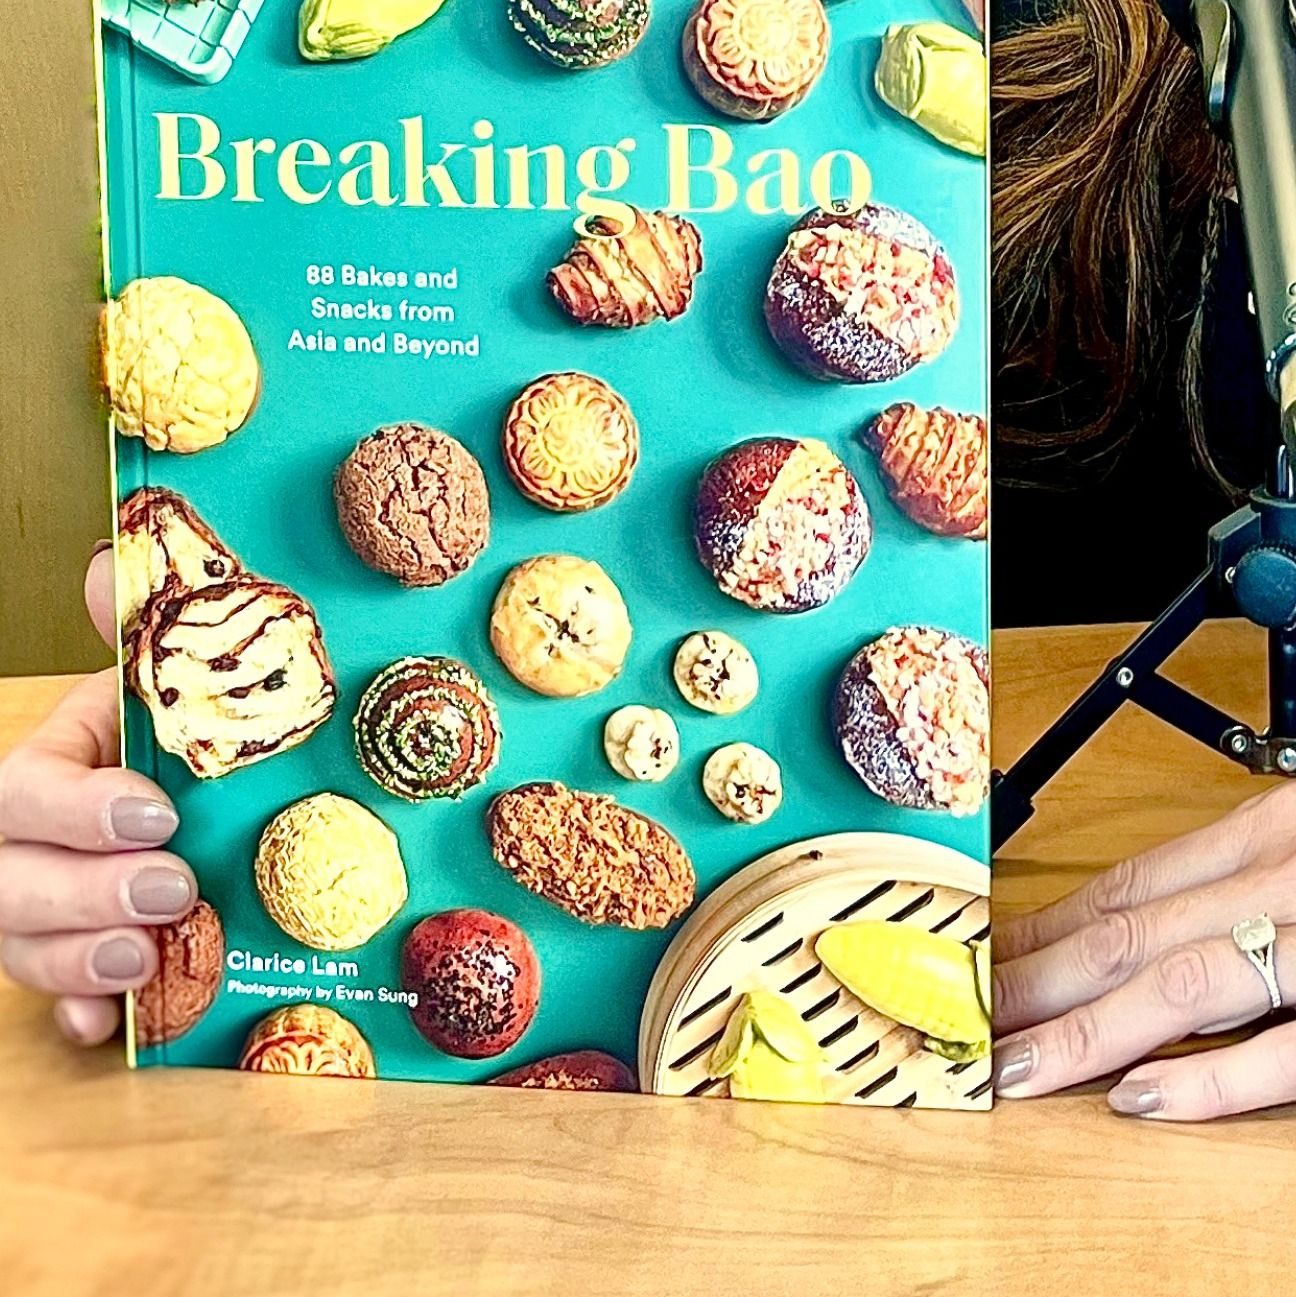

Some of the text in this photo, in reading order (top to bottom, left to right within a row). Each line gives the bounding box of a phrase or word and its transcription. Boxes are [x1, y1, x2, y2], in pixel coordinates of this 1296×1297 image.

[153, 112, 873, 239] Breaking Bao
[305, 265, 458, 291] 88 Bakes and
[310, 297, 456, 324] Snacks from
[287, 330, 480, 360] Asia and Beyond
[226, 950, 359, 977] Clarice Lam
[226, 979, 419, 1008] Photography by Evan Sung
